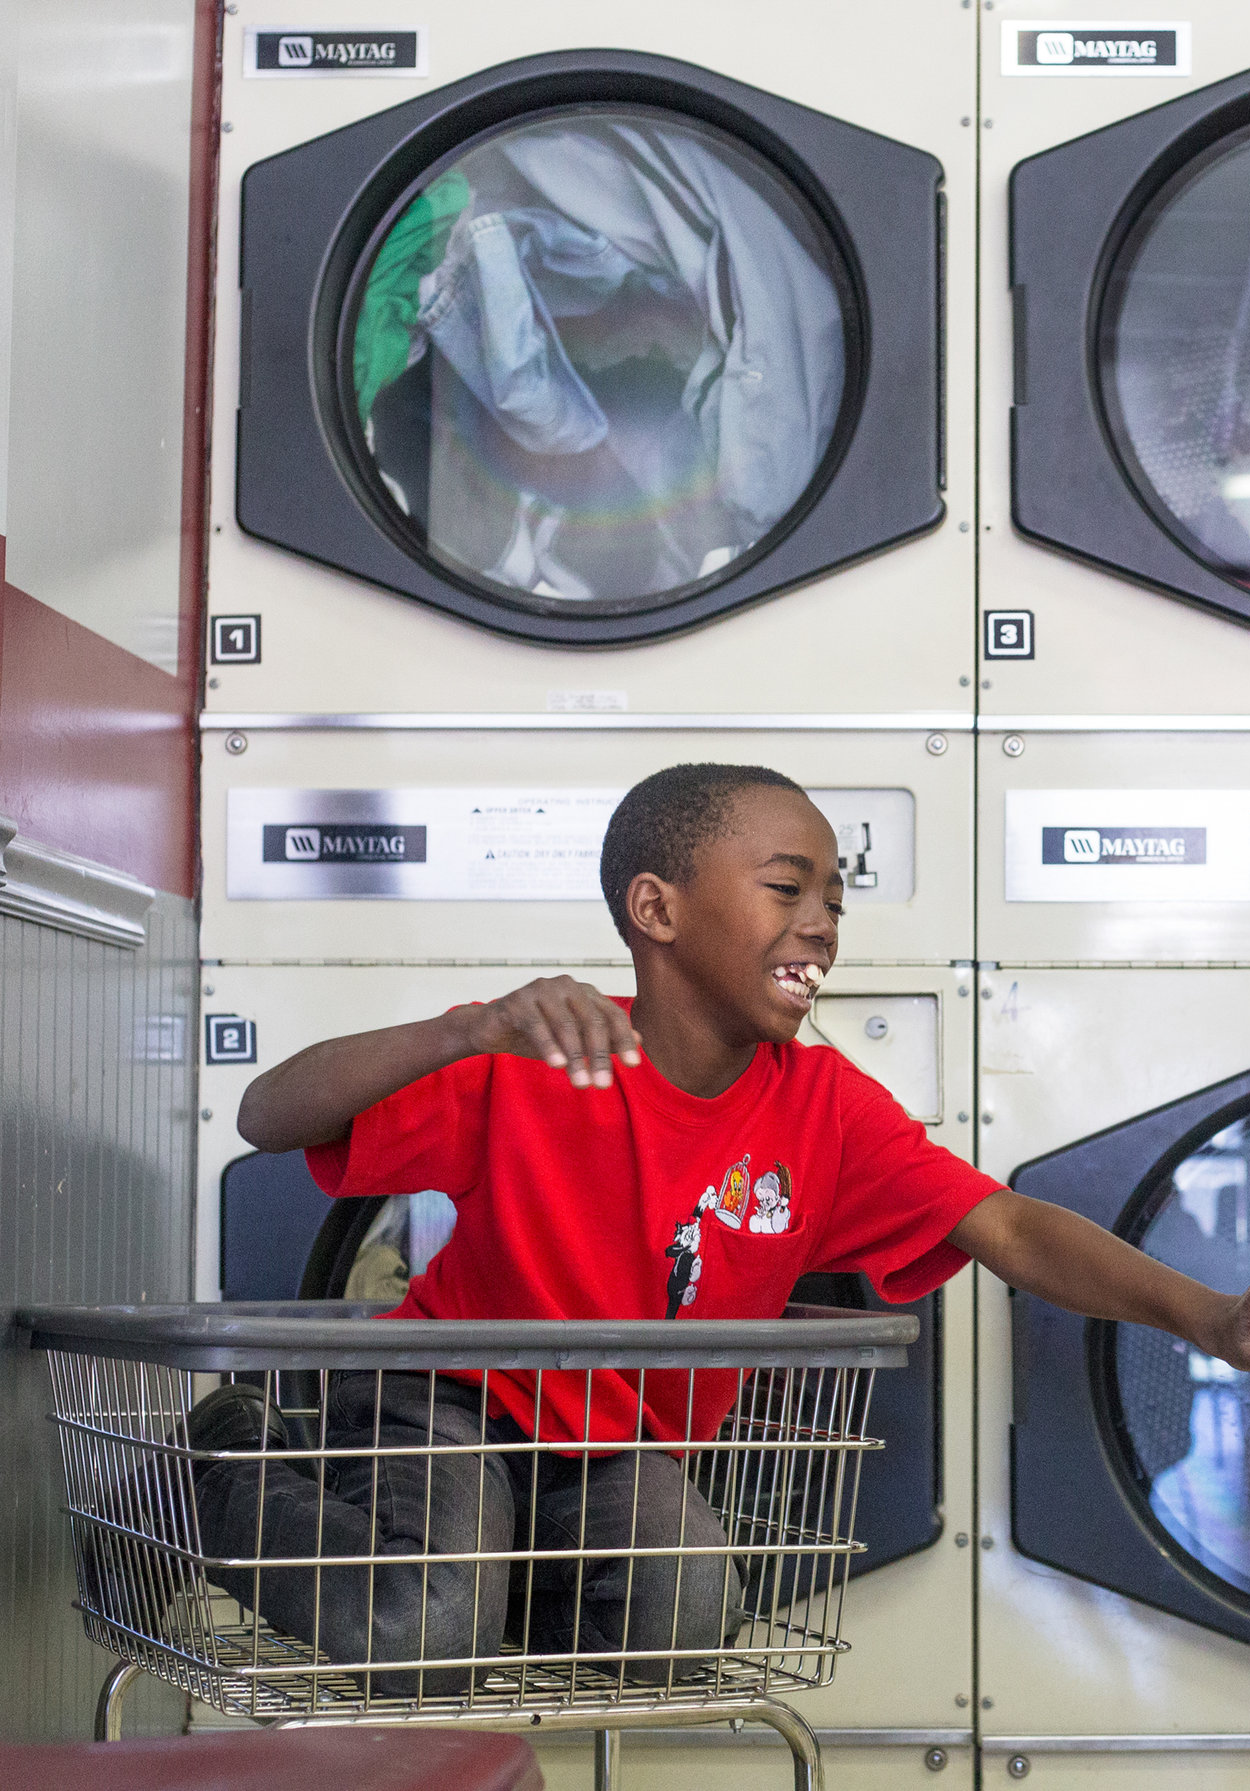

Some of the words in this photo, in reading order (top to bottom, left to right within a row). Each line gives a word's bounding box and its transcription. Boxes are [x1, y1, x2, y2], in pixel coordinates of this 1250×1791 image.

[315, 42, 396, 61] MAYTAG
[1073, 40, 1157, 58] MAYTAG
[229, 628, 244, 650] 1
[1000, 624, 1018, 645] 3
[323, 835, 405, 854] MAYTAG
[1101, 838, 1185, 856] MAYTAG
[223, 1028, 239, 1049] 2
